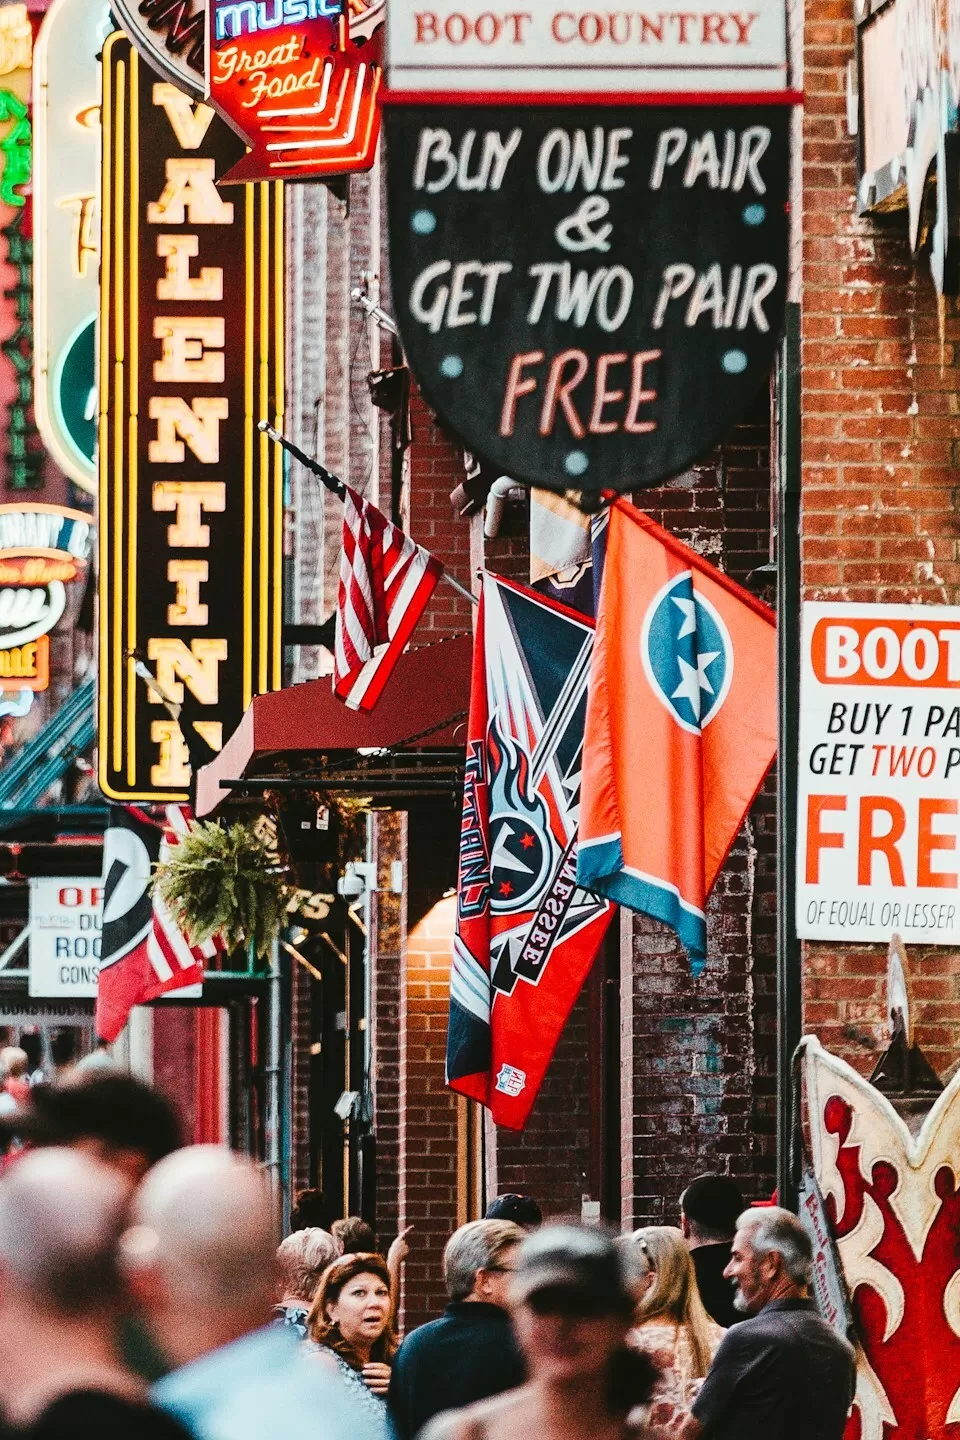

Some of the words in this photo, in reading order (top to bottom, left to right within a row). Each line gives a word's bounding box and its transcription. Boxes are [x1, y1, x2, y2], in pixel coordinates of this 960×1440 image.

[414, 11, 534, 46] BOOT
[551, 10, 762, 47] COUNTRY
[213, 35, 301, 84] Great
[242, 58, 321, 108] Food
[412, 126, 523, 195] BUY
[539, 126, 634, 195] ONE
[648, 124, 773, 196] PAIR
[554, 195, 616, 253] &
[409, 260, 515, 333] GET
[527, 260, 634, 334] TWO
[651, 262, 778, 334] PAIR
[499, 347, 663, 441] FREE
[827, 702, 892, 736] BUY
[901, 706, 914, 737] 1
[809, 743, 865, 776] GET
[871, 745, 937, 779] TWO
[806, 900, 827, 926] OF
[828, 901, 877, 927] EQUAL
[880, 903, 902, 929] OR
[904, 904, 957, 930] LESSER
